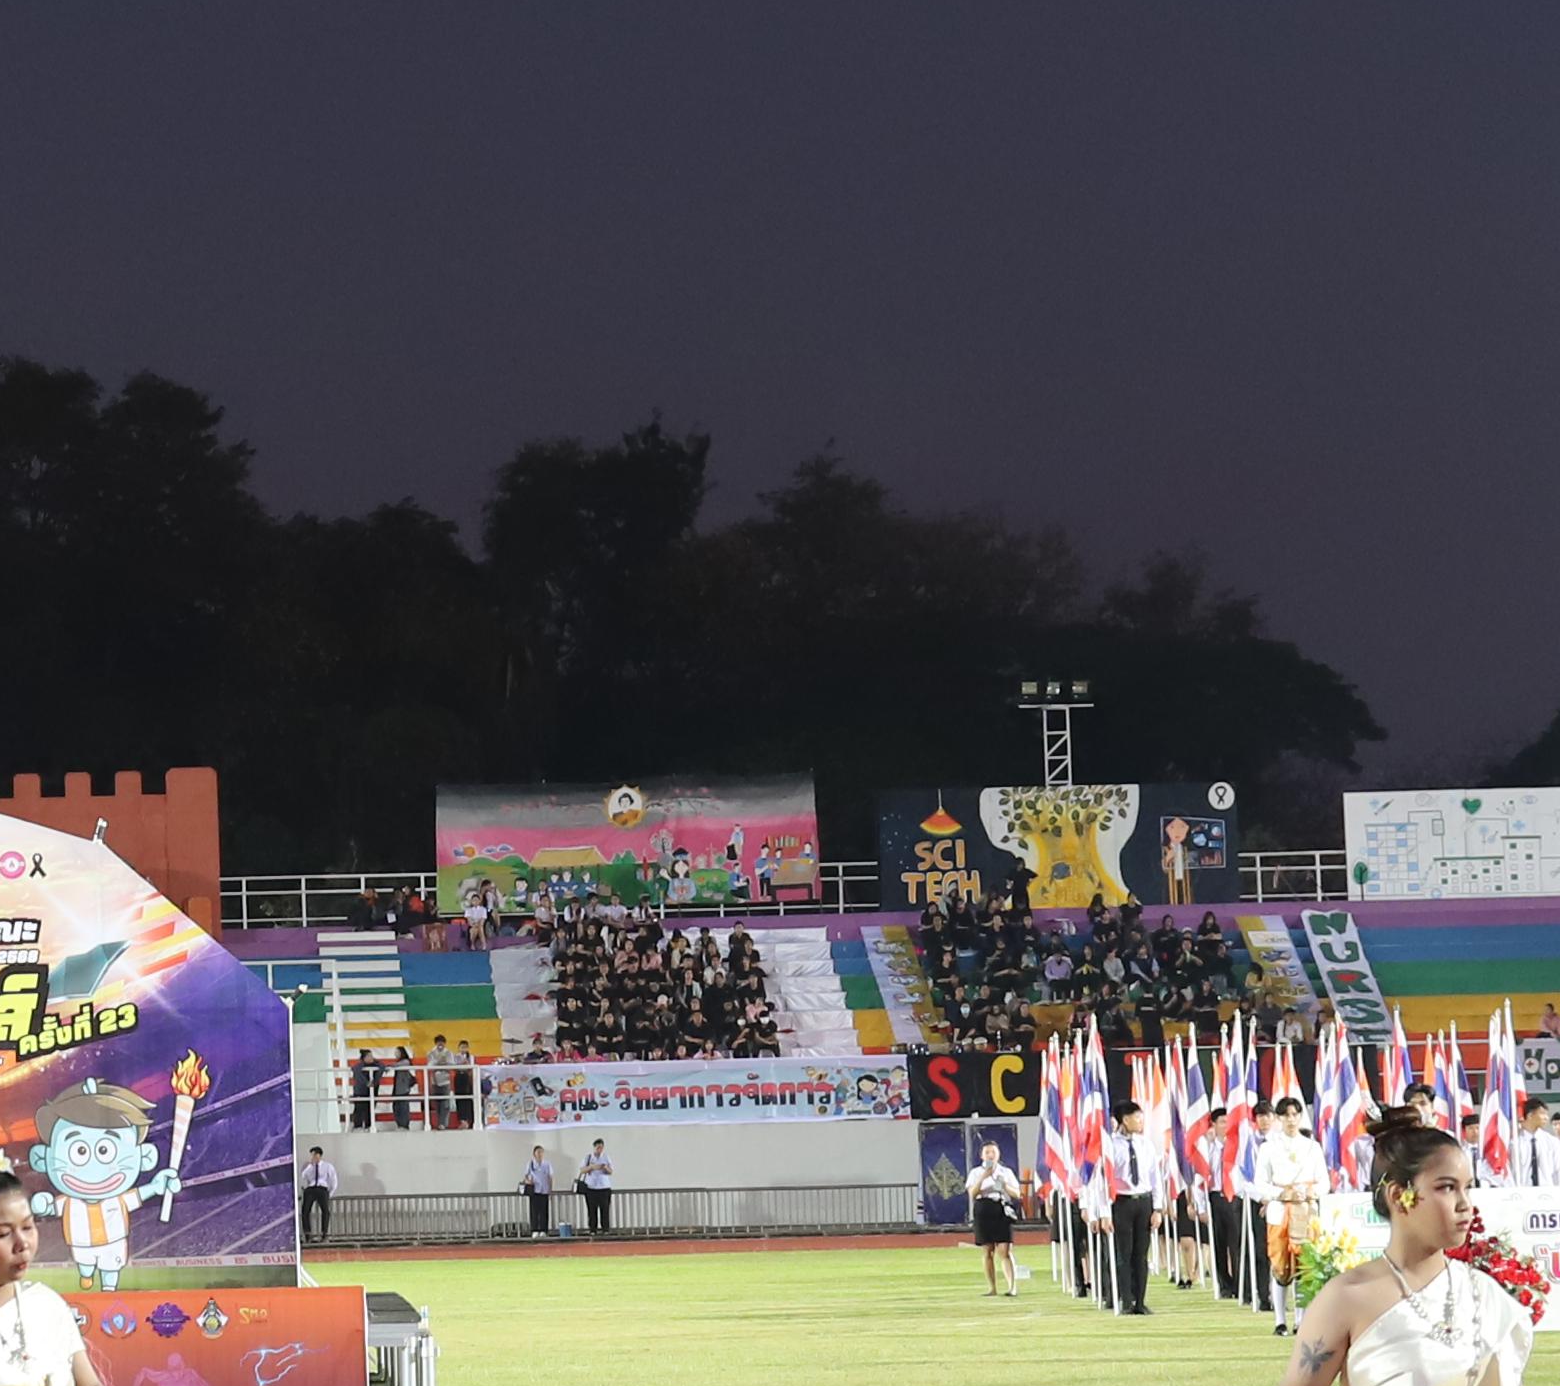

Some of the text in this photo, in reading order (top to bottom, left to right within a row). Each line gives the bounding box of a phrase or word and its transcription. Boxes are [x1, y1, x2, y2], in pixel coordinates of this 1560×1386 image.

[914, 839, 966, 871] SCI
[19, 1003, 137, 1055] ครั้งที่ 23
[263, 1254, 296, 1264] BUSI
